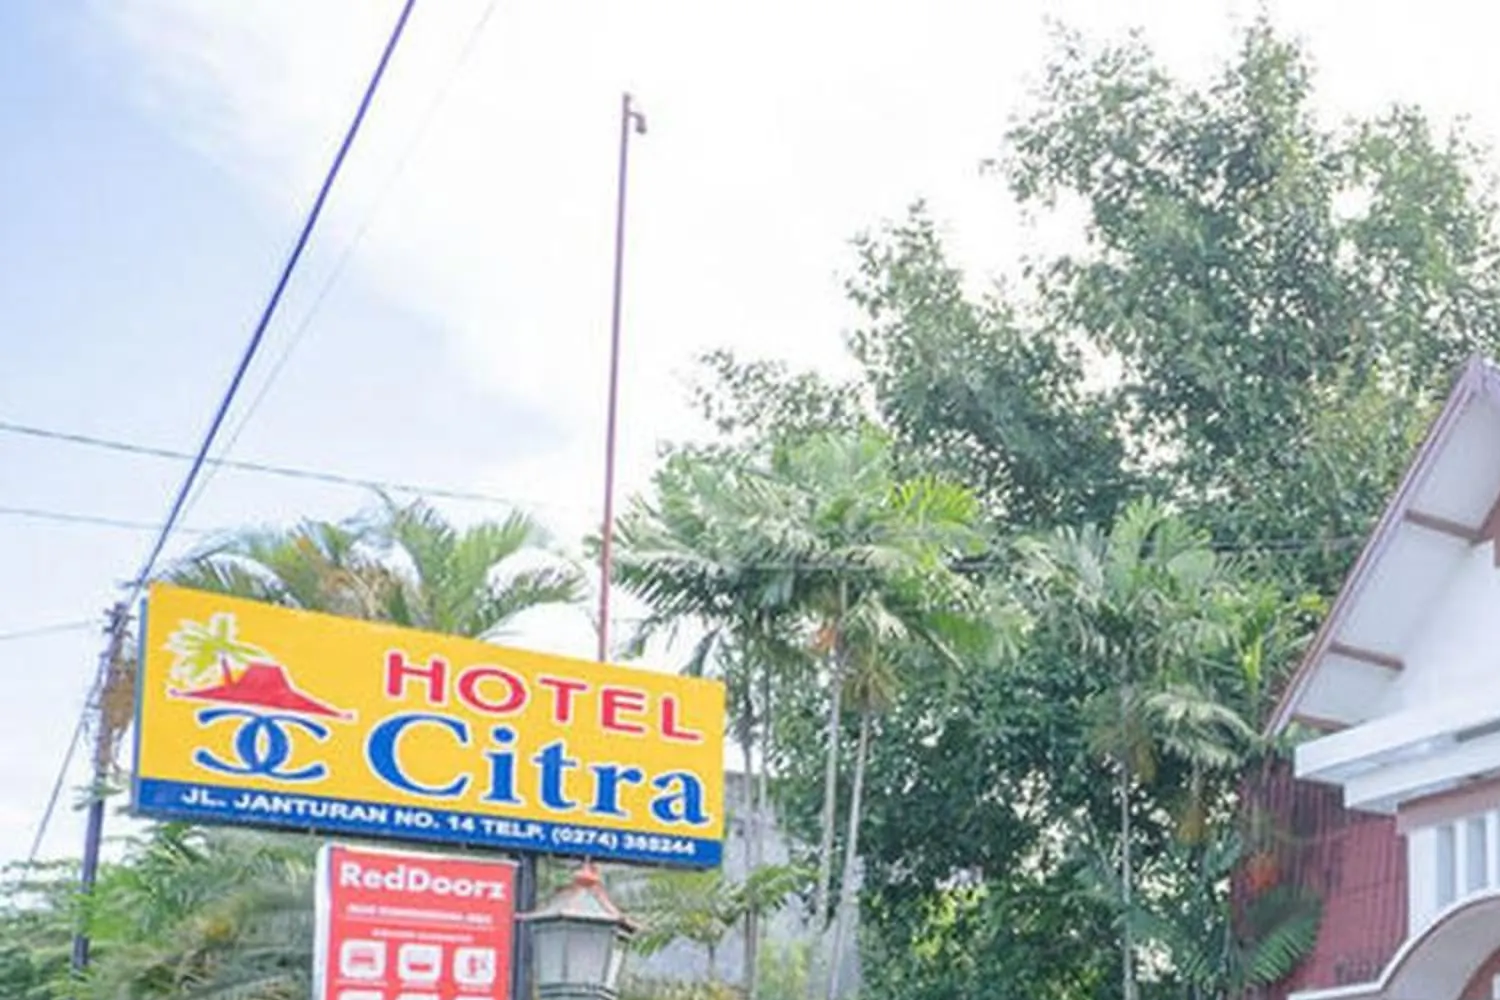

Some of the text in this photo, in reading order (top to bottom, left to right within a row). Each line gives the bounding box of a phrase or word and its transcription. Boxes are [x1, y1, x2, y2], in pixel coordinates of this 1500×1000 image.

[386, 650, 702, 742] HOTEL
[366, 712, 711, 827] Citra
[181, 787, 227, 808] JL.
[233, 792, 389, 825] JANTURAN
[394, 809, 441, 830] NO.
[448, 816, 476, 832] 14
[551, 826, 618, 850] (0274)
[339, 860, 507, 900] RedDoorz
